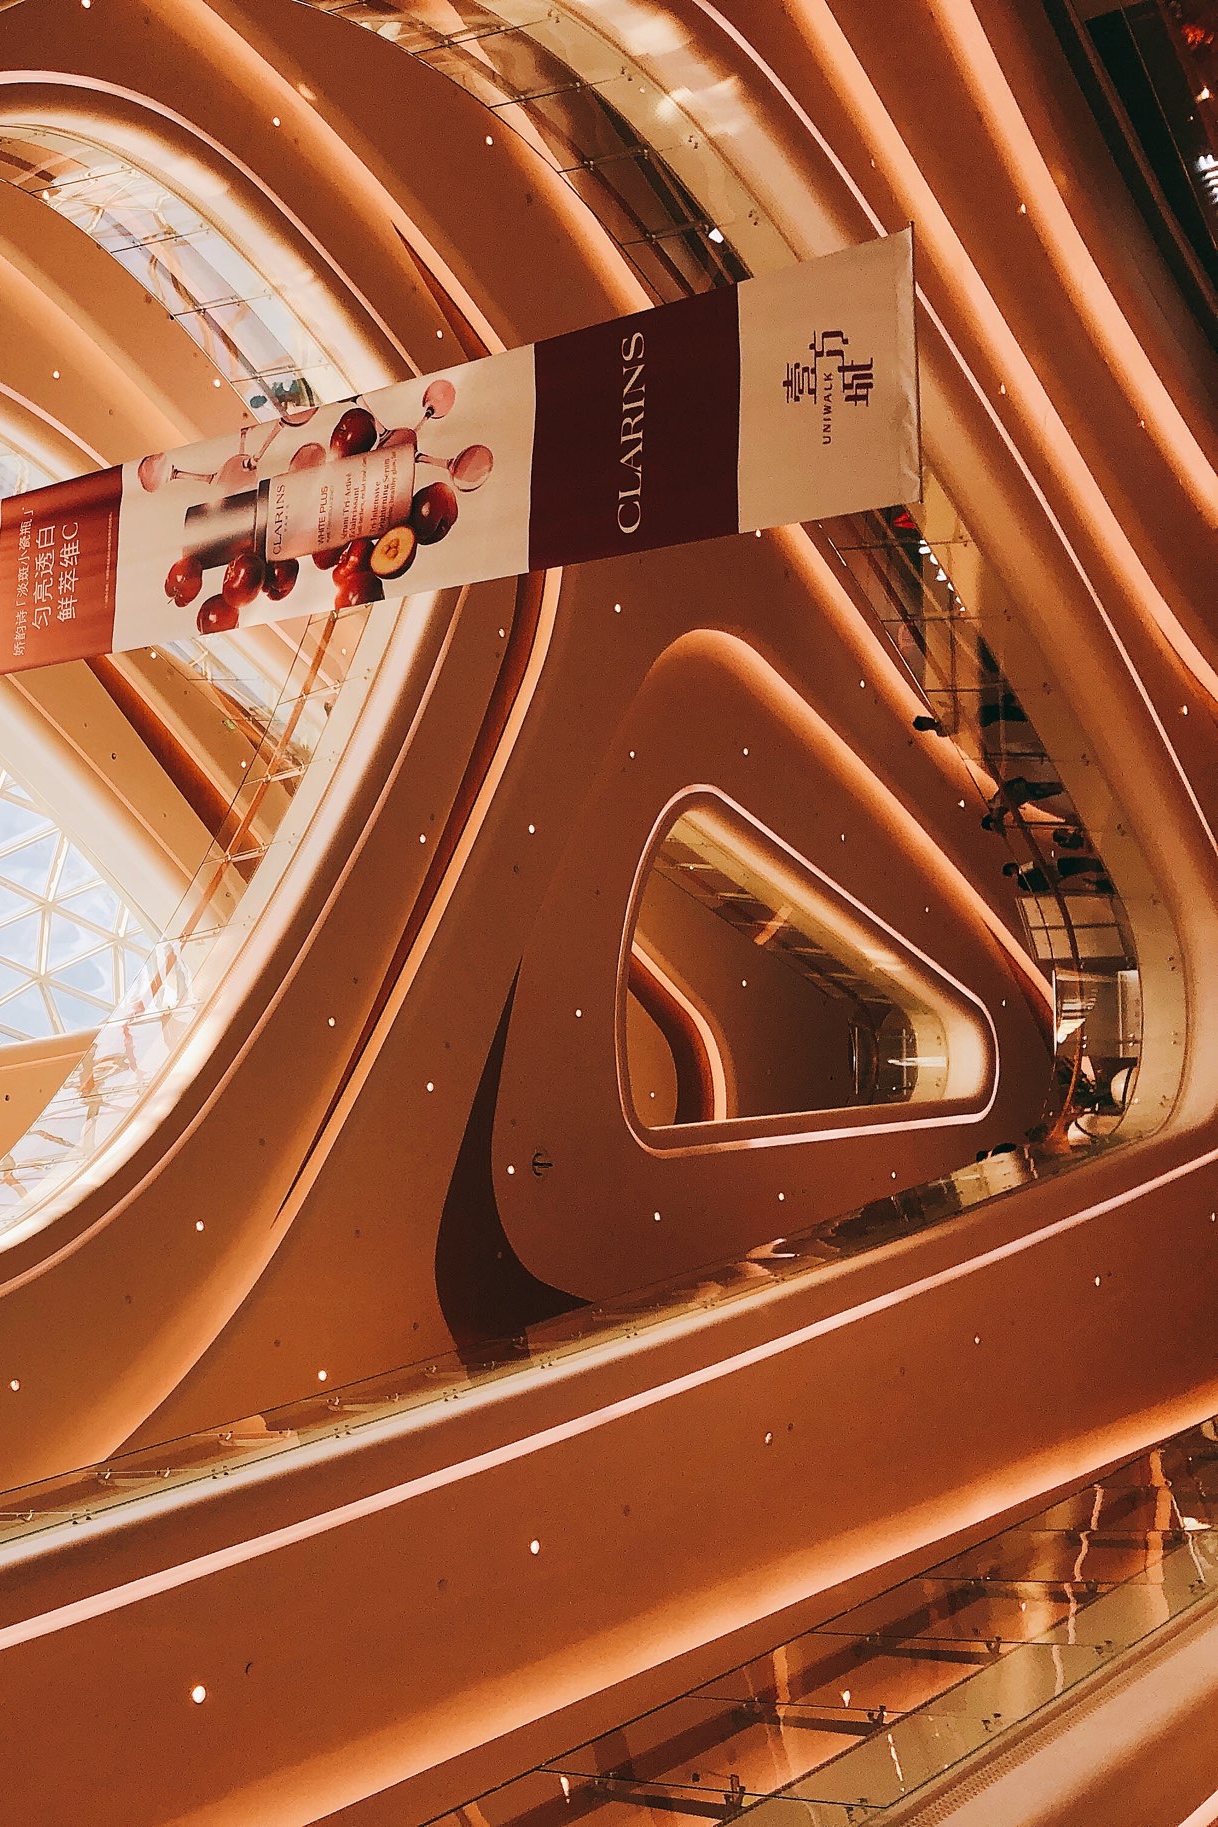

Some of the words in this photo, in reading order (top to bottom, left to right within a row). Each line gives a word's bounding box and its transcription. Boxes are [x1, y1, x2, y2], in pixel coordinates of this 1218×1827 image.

[617, 331, 646, 534] CLARINS
[822, 373, 833, 444] UNIWALK
[273, 484, 286, 555] CLARINS
[317, 517, 326, 545] WHITE
[319, 486, 329, 514] PLUS
[32, 525, 55, 629] 匀亮透白
[57, 522, 80, 622] 鲜萃维C
